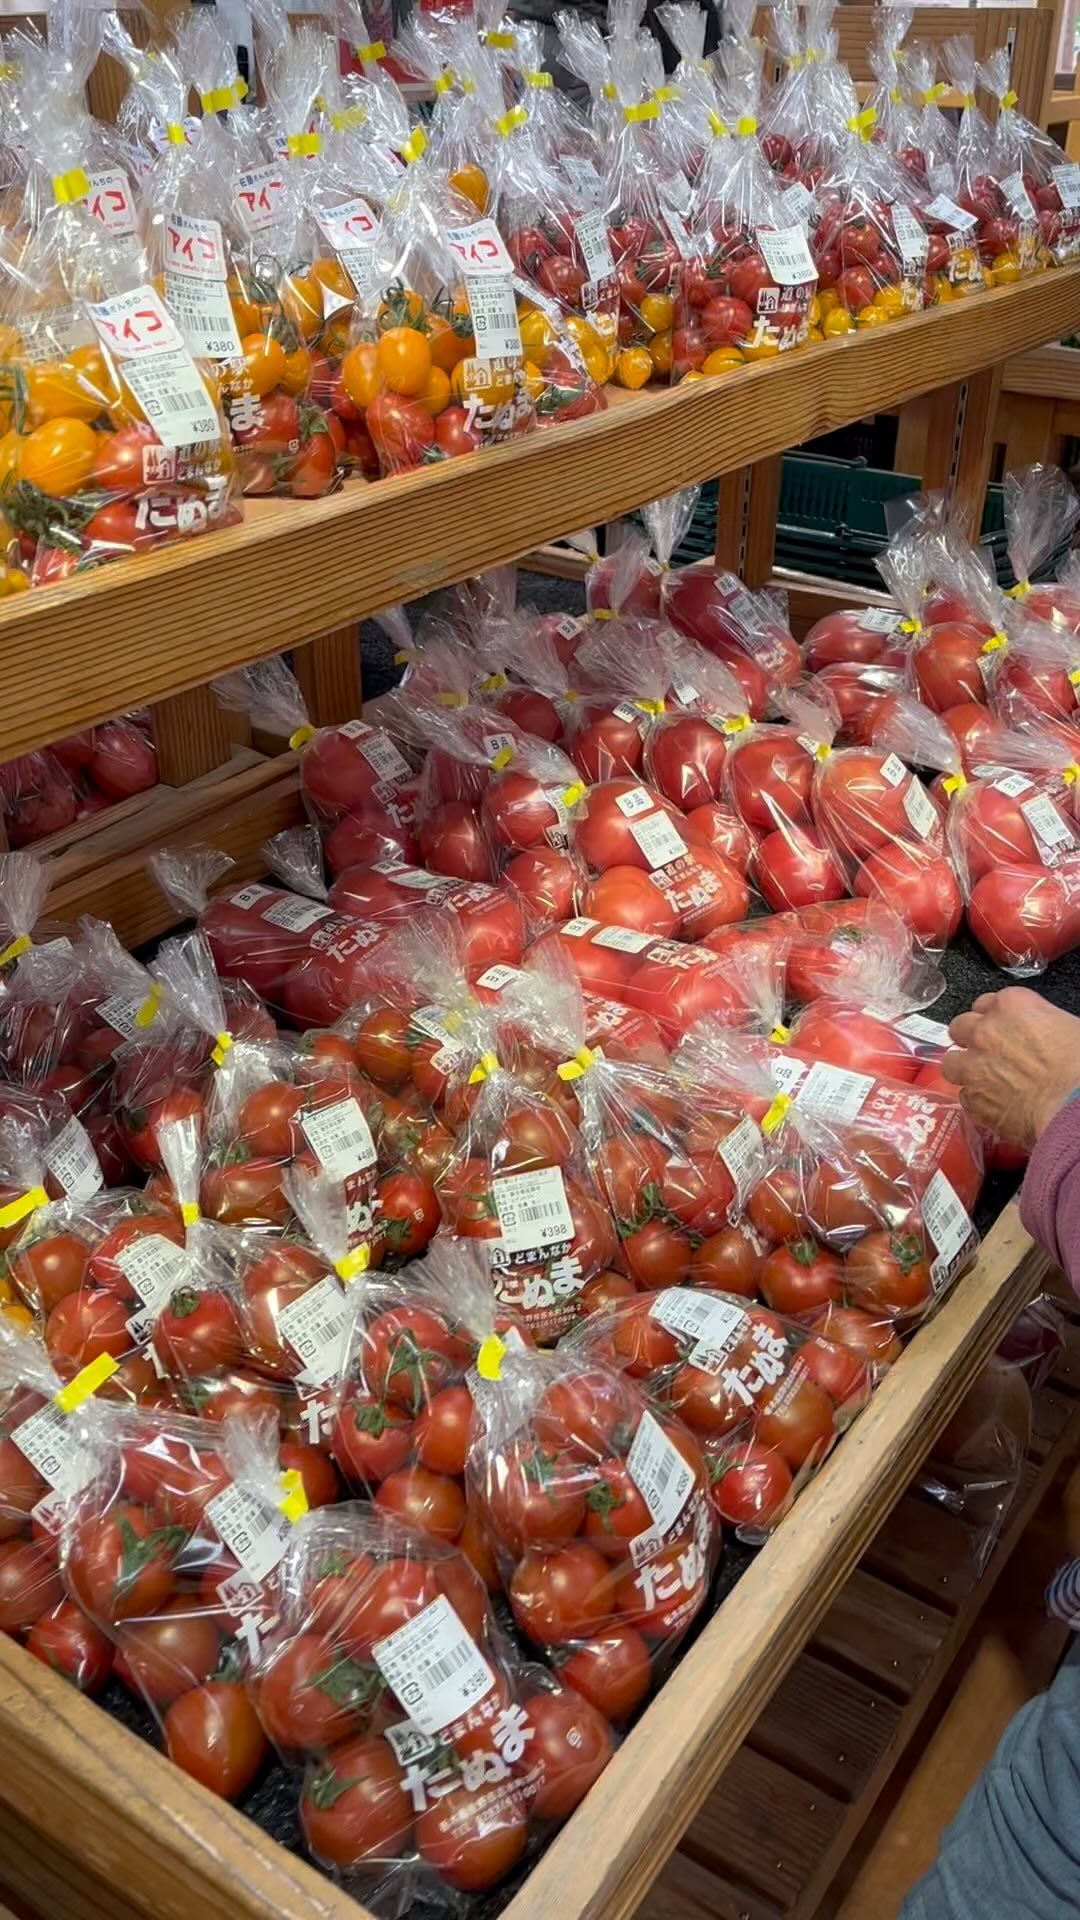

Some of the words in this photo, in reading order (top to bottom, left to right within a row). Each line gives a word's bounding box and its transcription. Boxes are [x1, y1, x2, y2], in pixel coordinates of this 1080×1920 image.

[167, 226, 217, 262] アイコ
[449, 239, 499, 263] アイコ
[204, 340, 235, 352] ¥380
[191, 418, 215, 433] ¥380
[663, 870, 723, 913] たぬま
[541, 1223, 568, 1239] ¥398
[514, 1242, 573, 1265] どまんなか
[721, 1322, 790, 1407] たぬま
[438, 1693, 501, 1747] どまんなか
[400, 1703, 537, 1813] たぬま
